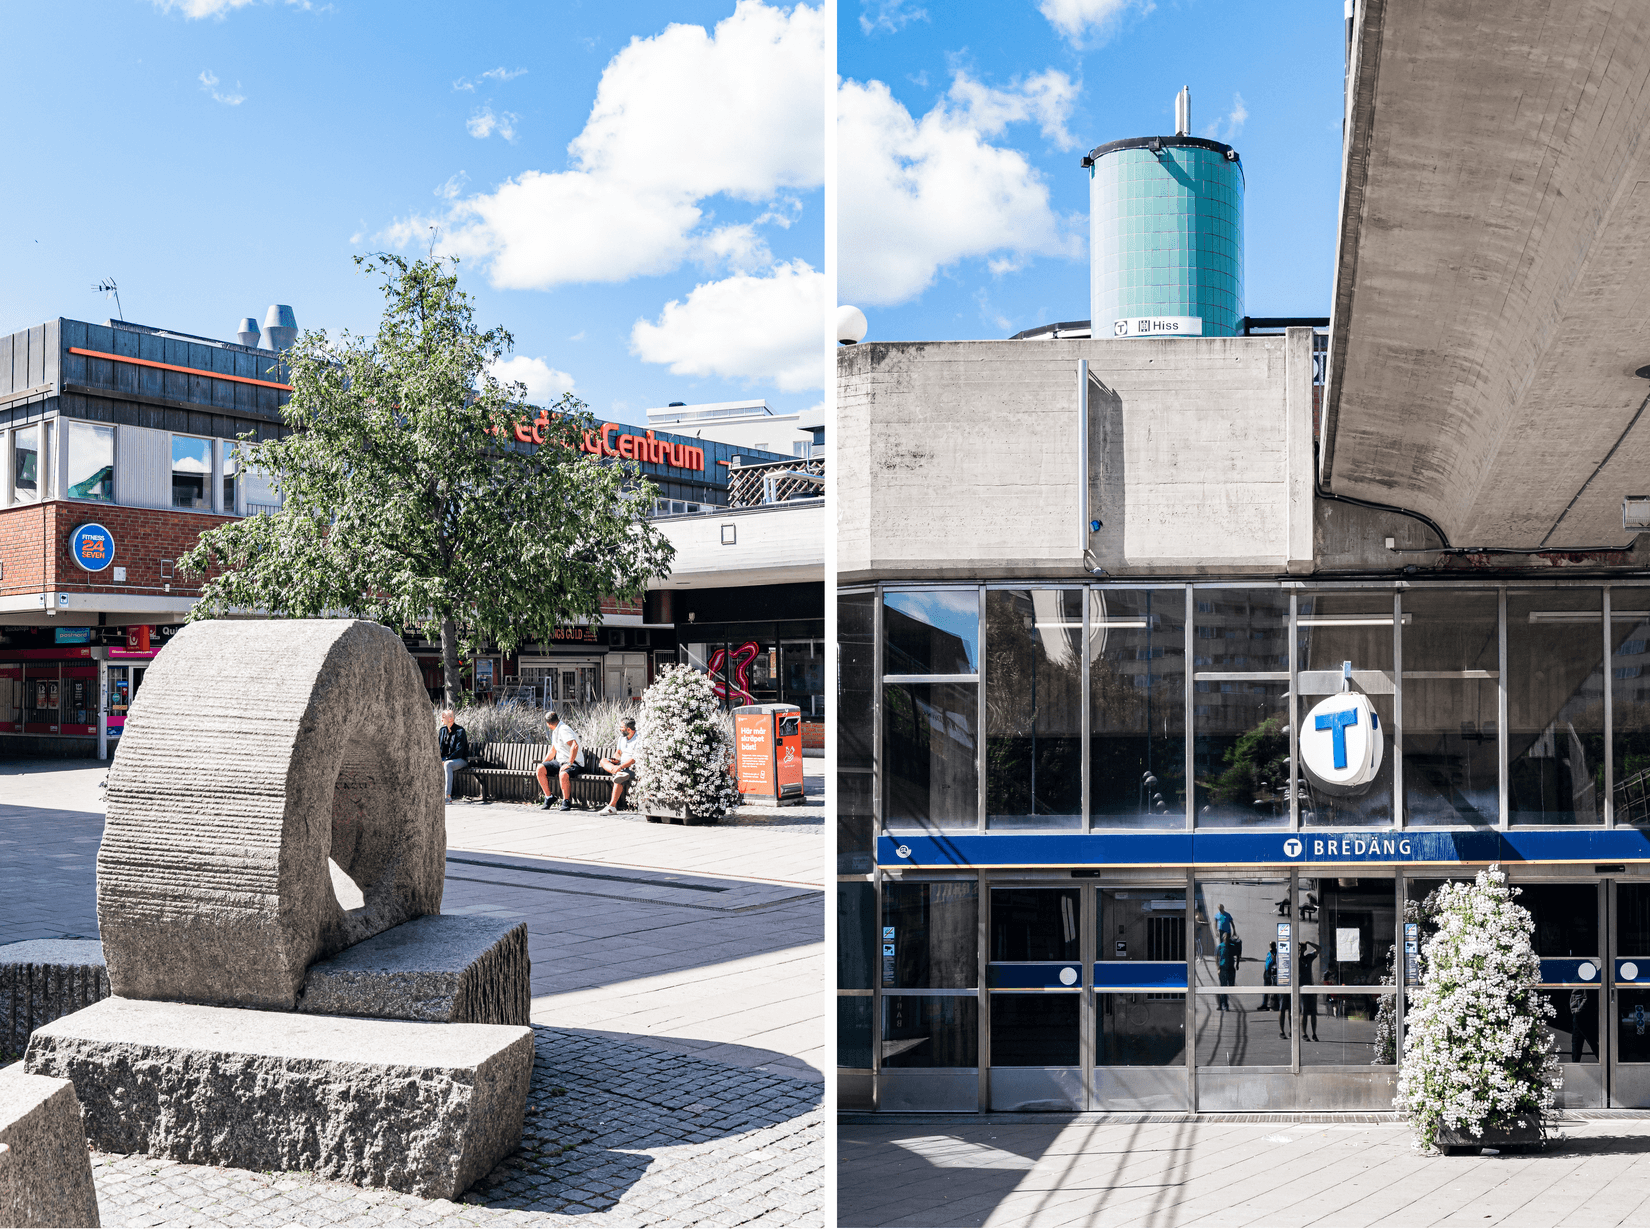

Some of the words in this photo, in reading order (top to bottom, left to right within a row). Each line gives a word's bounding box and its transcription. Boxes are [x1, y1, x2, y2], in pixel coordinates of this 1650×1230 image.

[1153, 321, 1179, 330] Hiss
[82, 540, 105, 552] 24
[82, 551, 105, 559] SEVEN
[565, 628, 583, 640] GULD
[740, 726, 753, 735] Här
[753, 726, 767, 735] mår
[741, 735, 765, 743] skräpet
[1315, 707, 1358, 770] T
[741, 743, 757, 751] bäst!
[1314, 836, 1411, 855] BREDÄNG
